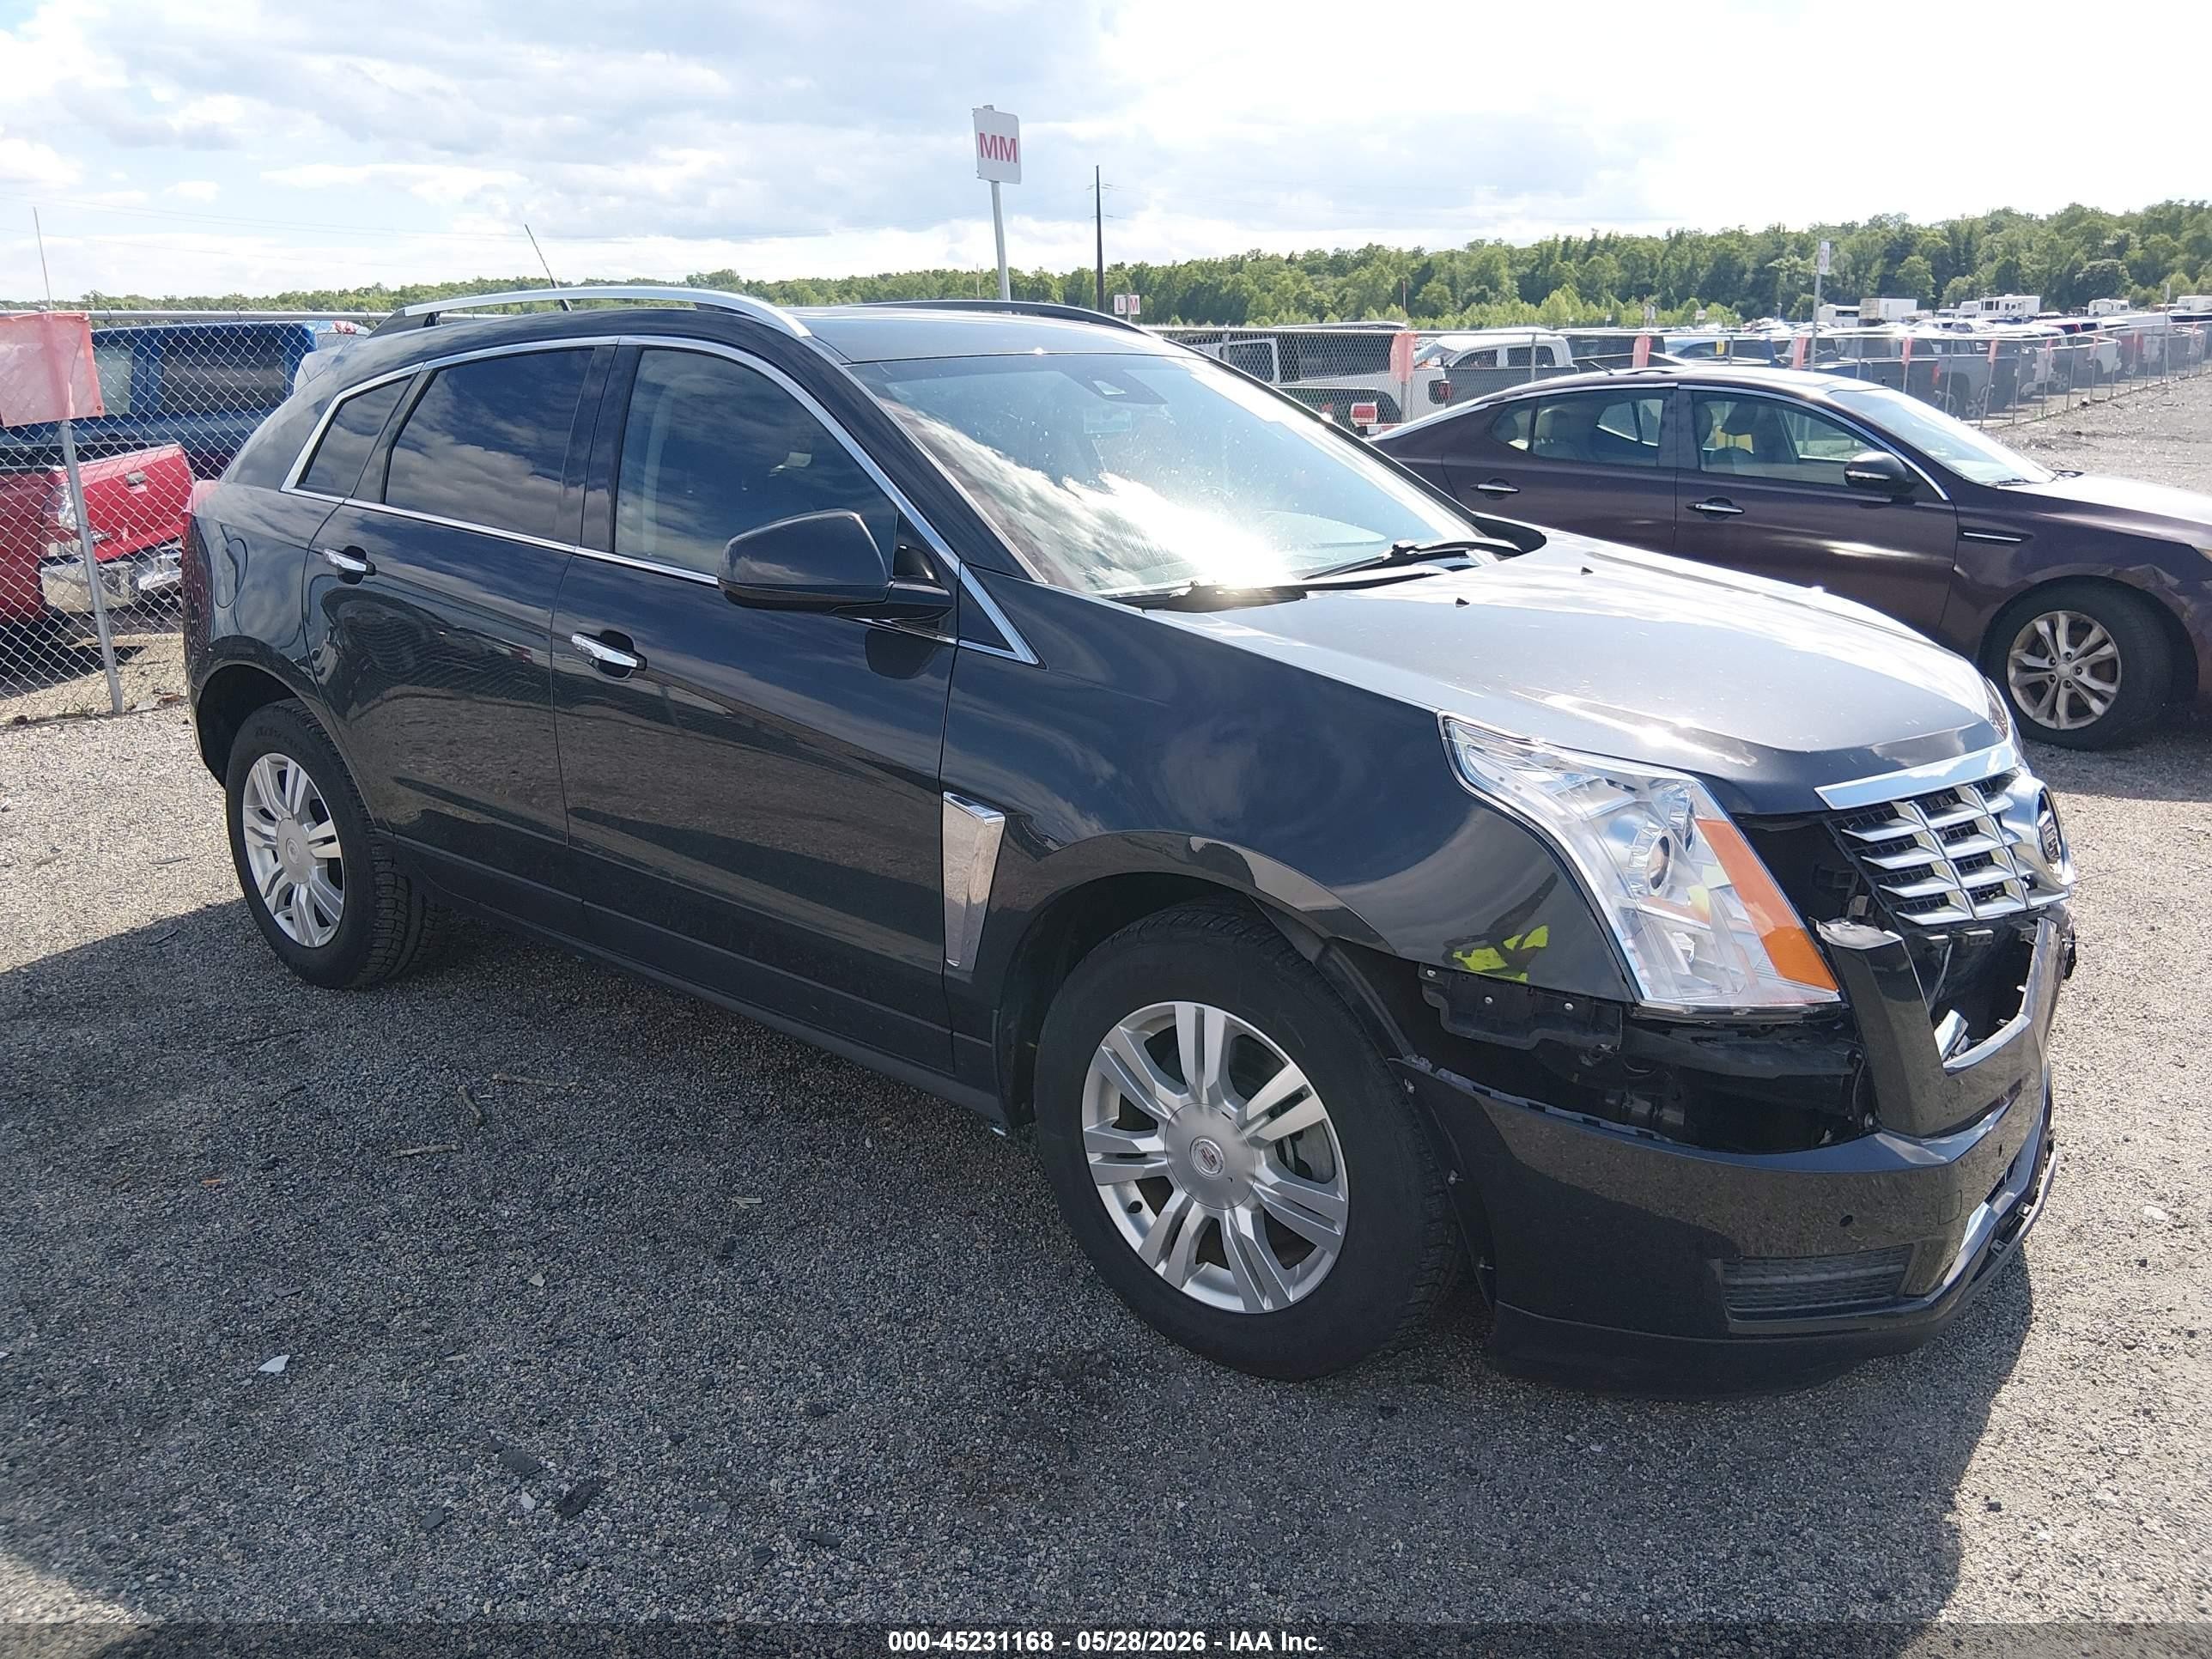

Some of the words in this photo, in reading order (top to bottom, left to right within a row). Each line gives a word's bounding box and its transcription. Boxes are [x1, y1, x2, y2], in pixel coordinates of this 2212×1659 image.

[979, 132, 1018, 163] MM
[1118, 298, 1123, 311] L
[1130, 298, 1138, 311] M
